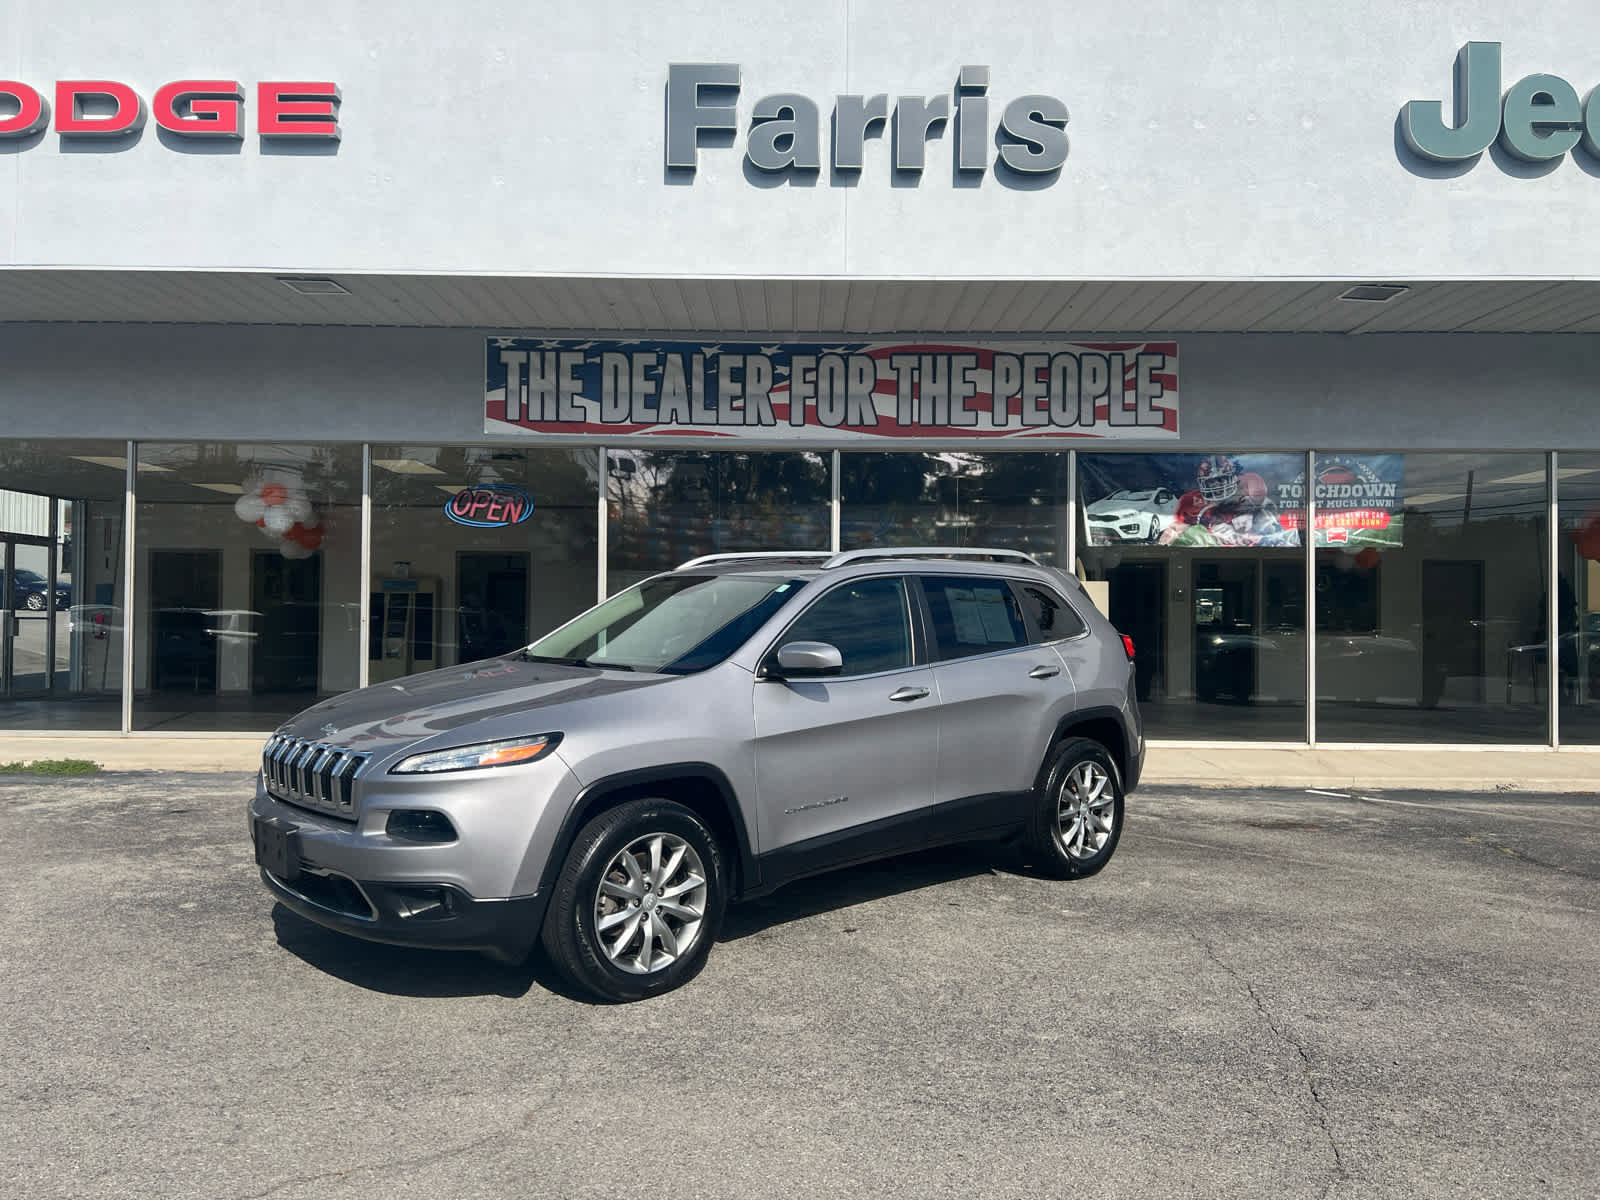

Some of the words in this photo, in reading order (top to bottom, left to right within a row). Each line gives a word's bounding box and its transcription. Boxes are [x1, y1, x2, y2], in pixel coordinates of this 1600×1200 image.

[667, 62, 1070, 175] Farris
[1405, 41, 1600, 160] Je
[499, 350, 587, 423] THE
[600, 351, 776, 427] DEALER
[789, 352, 878, 428] FOR
[889, 352, 979, 427] THE
[992, 352, 1166, 428] PEOPLE
[453, 489, 523, 523] OPEN
[1278, 483, 1397, 498] TOCHDOWN
[1279, 500, 1299, 509] FOR
[1326, 500, 1358, 508] MUCH
